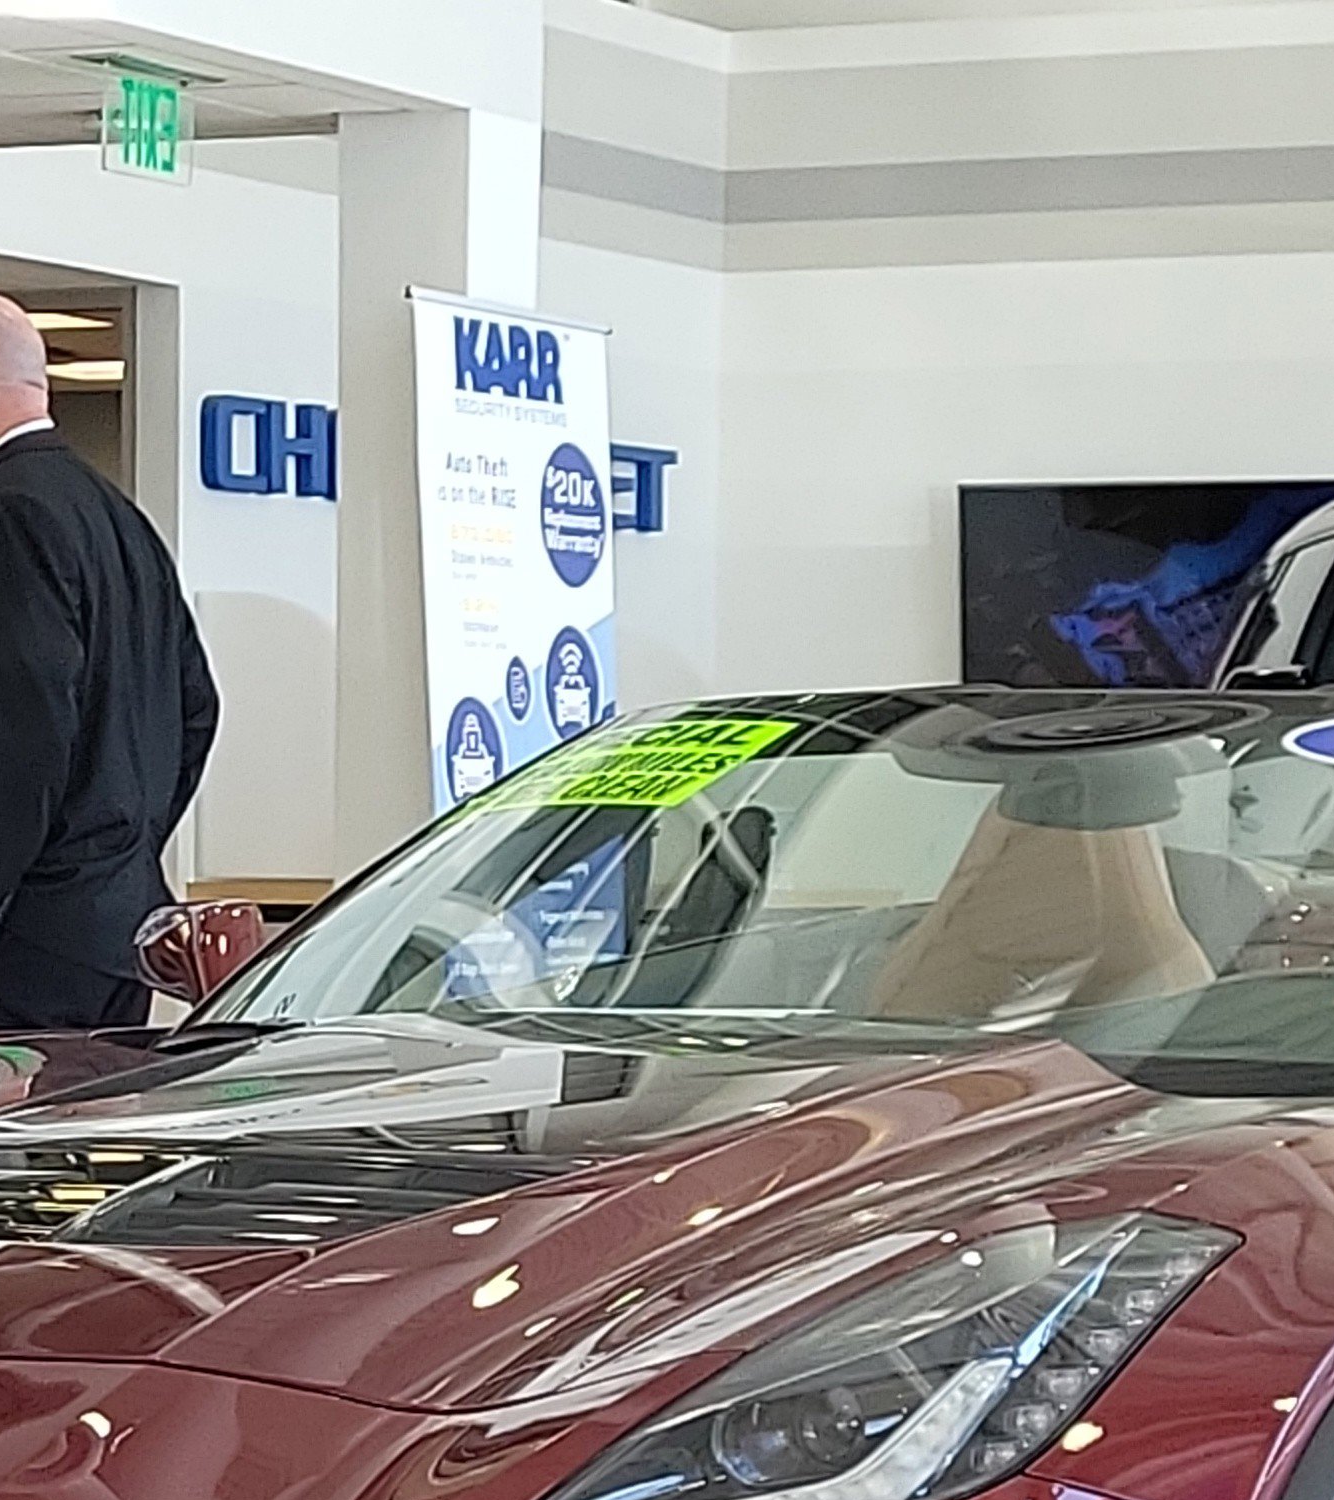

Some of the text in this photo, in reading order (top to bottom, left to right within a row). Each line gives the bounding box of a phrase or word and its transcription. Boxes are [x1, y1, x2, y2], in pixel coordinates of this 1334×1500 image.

[453, 316, 564, 405] KARR
[455, 397, 567, 428] SECURITY SYSTEMS
[200, 393, 338, 502] CH
[445, 452, 509, 477] Auto Theft
[545, 466, 596, 508] $20K
